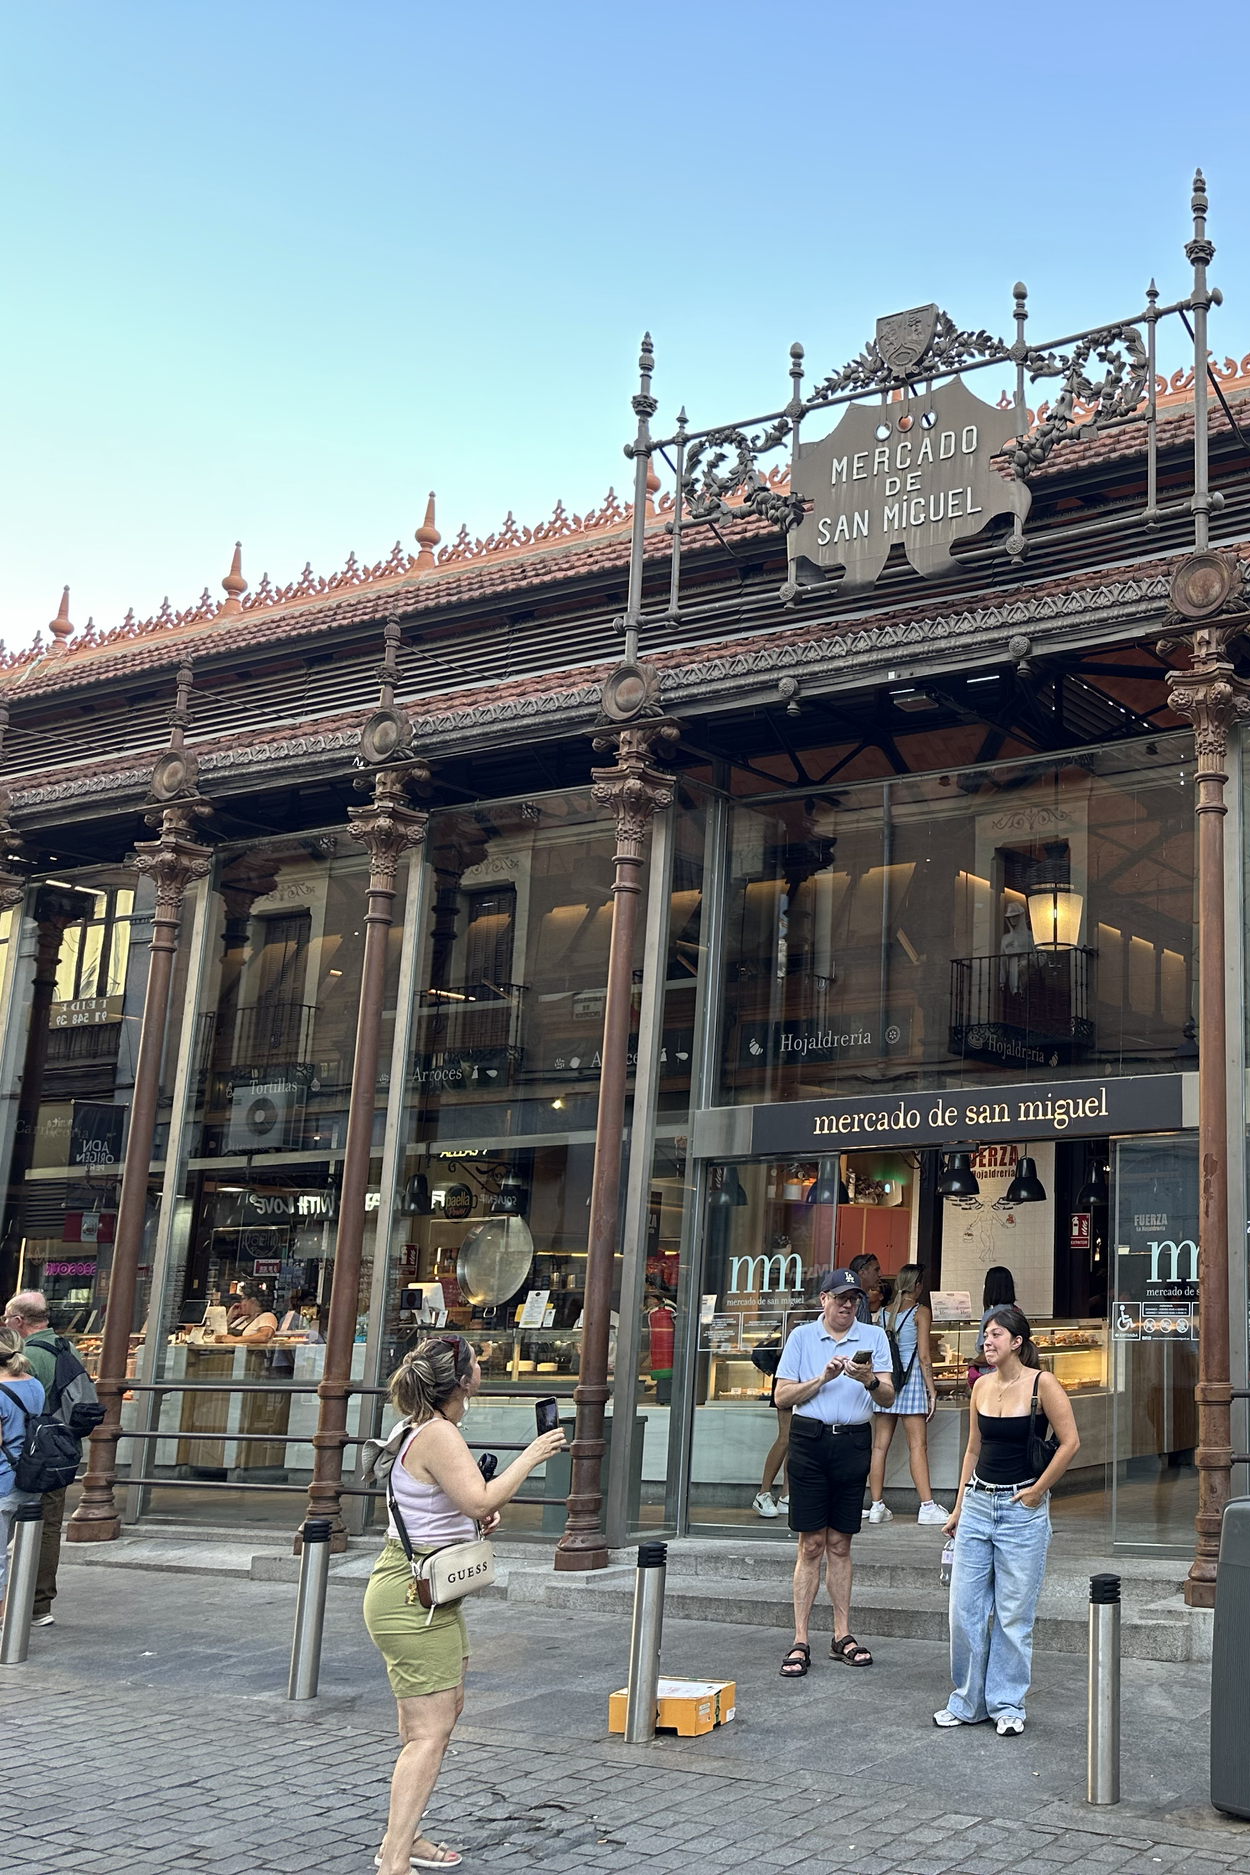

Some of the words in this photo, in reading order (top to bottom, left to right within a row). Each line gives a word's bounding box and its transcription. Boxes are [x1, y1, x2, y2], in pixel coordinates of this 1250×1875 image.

[831, 425, 978, 485] MERCADO
[885, 471, 922, 497] DE
[817, 508, 870, 546] SAN
[780, 1029, 872, 1056] Hojaldrería
[412, 1067, 463, 1082] Arroces
[250, 1078, 298, 1095] Tortillas
[813, 1101, 921, 1135] mercado
[928, 1099, 958, 1127] de
[965, 1103, 1011, 1125] san
[1017, 1087, 1109, 1131] miguel
[969, 1145, 1018, 1168] UERZA
[1134, 1214, 1168, 1226] FUERZA
[726, 1297, 757, 1306] mercado
[757, 1297, 767, 1306] de
[780, 1295, 805, 1307] miguel
[1147, 1287, 1182, 1297] mercado
[1184, 1287, 1195, 1297] de
[447, 1561, 488, 1583] GUESS
